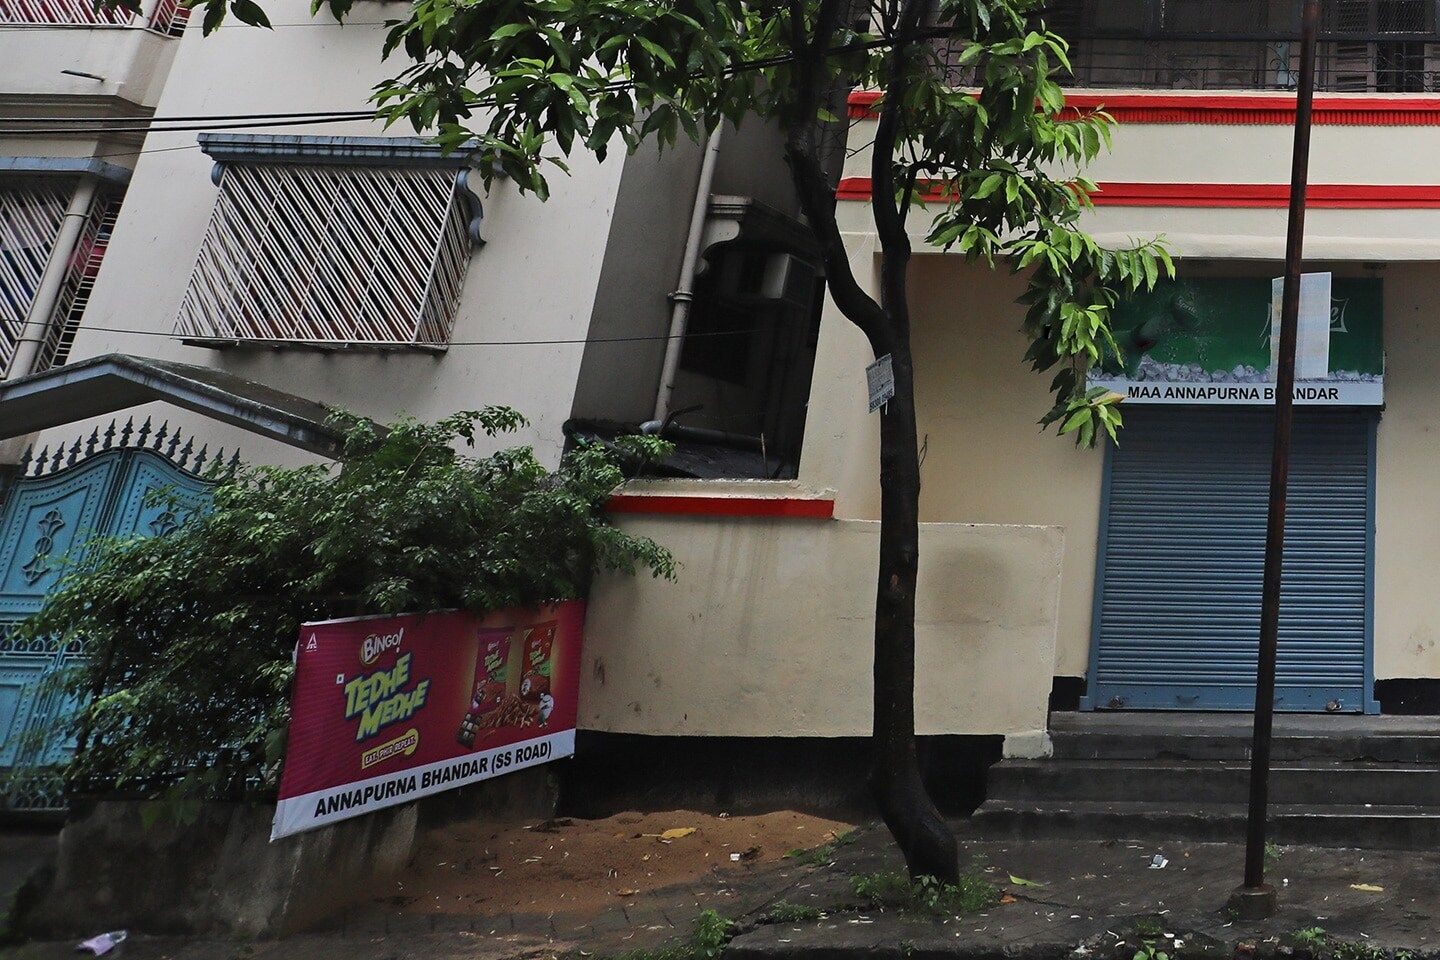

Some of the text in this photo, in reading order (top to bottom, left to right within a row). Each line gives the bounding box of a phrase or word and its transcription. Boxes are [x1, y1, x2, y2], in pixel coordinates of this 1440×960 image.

[1128, 386, 1339, 400] MAA ANNAPURNA BNDAR
[362, 628, 404, 663] BINGO!
[344, 652, 411, 719] TEDHE
[356, 680, 431, 742] MEDHE
[314, 741, 552, 818] ANNAPURNA BHANDAR (SS ROAD)
